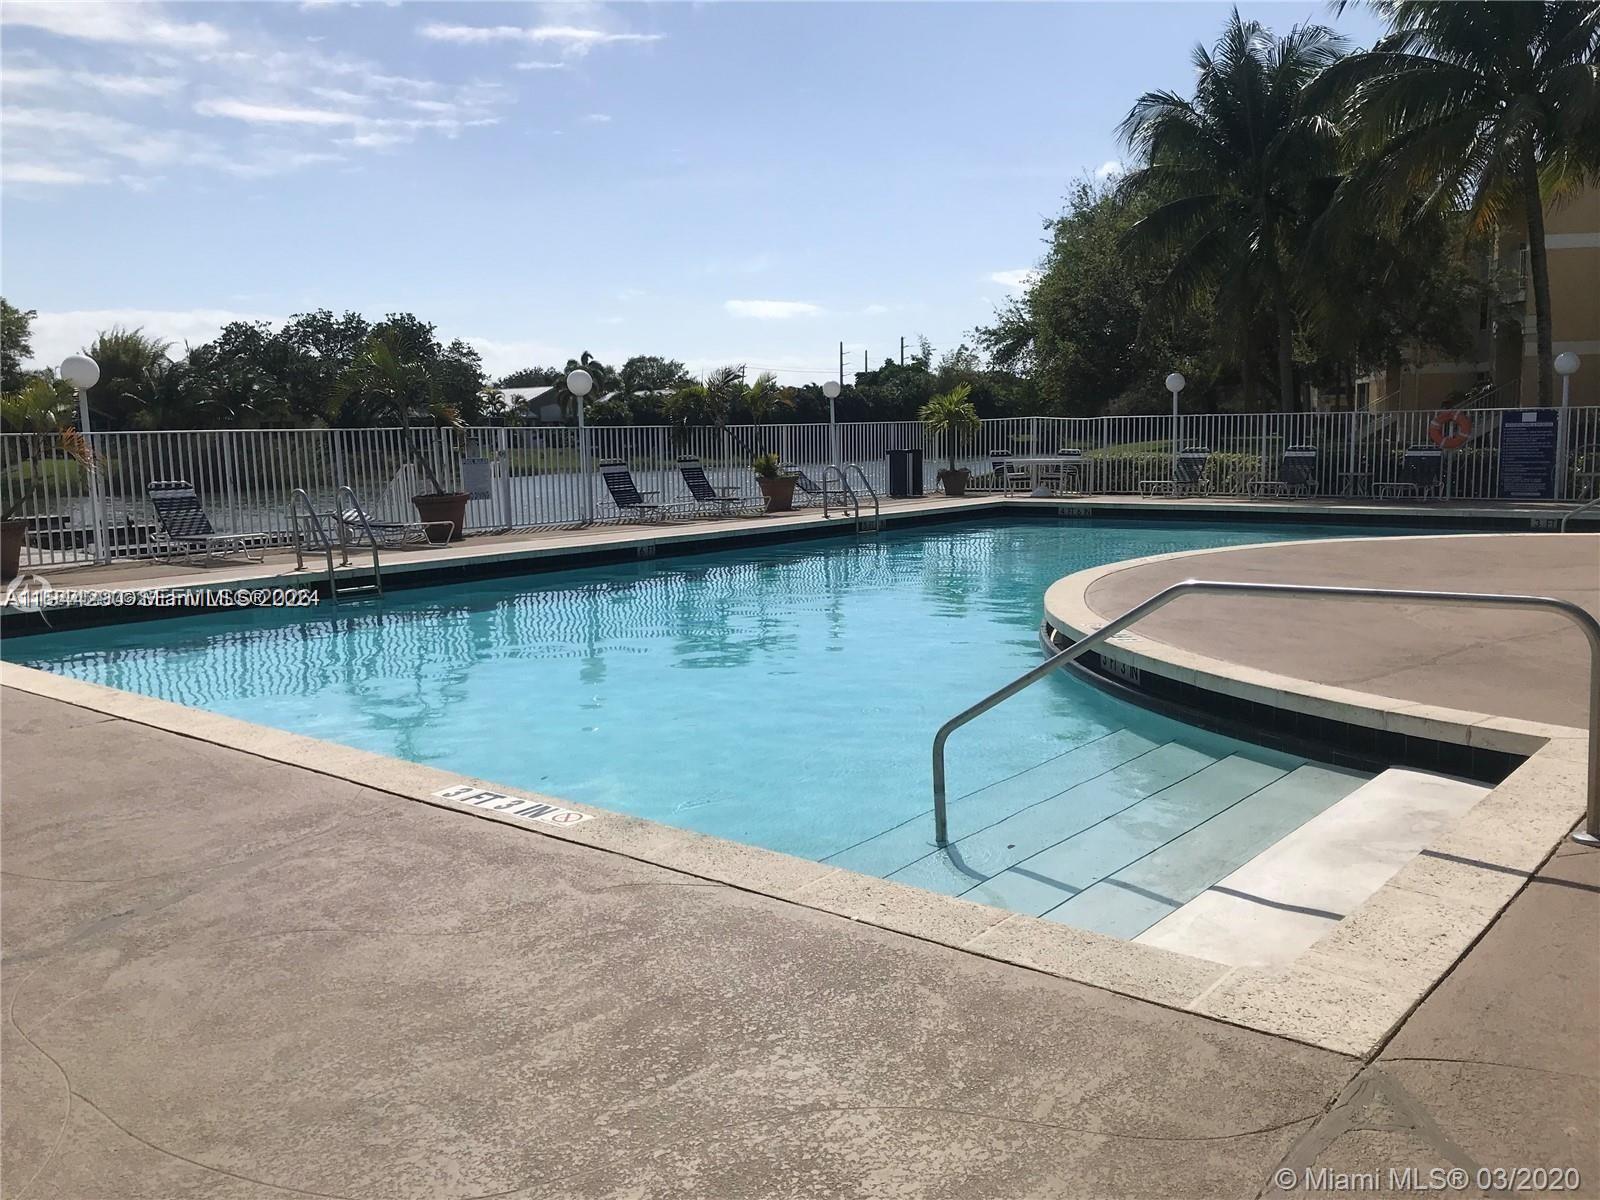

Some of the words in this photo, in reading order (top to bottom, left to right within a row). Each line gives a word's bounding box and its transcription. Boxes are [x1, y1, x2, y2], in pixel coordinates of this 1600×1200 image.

[441, 787, 474, 798] 3
[460, 791, 507, 805] FT
[493, 799, 526, 810] 3
[513, 803, 559, 819] IN
